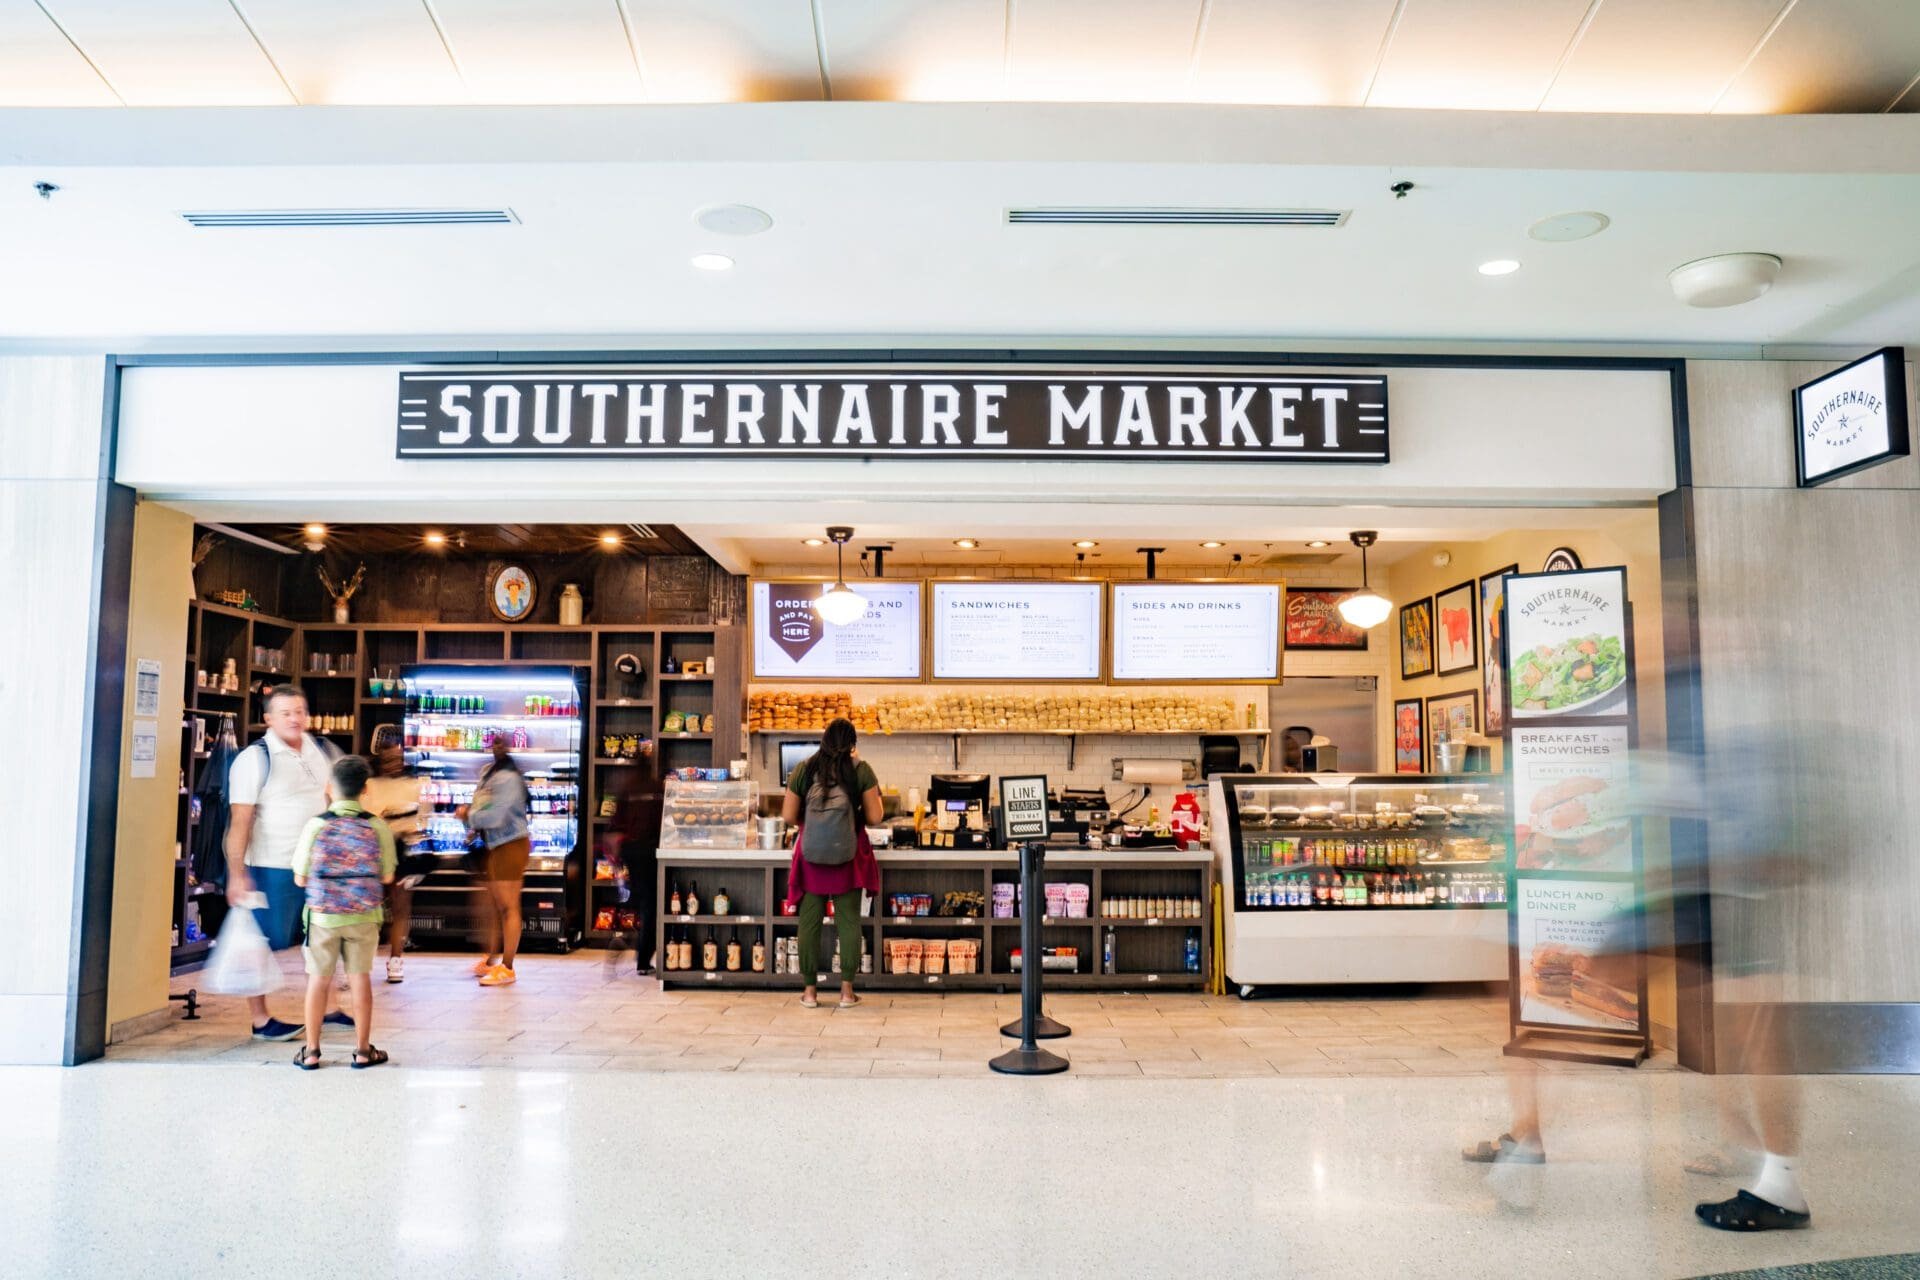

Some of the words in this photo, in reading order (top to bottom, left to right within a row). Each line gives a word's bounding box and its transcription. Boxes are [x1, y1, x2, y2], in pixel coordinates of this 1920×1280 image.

[438, 384, 1009, 444] SOUTHERNAIRE
[1047, 385, 1349, 447] MARKET
[1808, 390, 1882, 440] SOUTHERNAIRE
[1826, 425, 1864, 447] MARKET
[951, 601, 1031, 609] SANDWICHES
[1132, 602, 1166, 610] SIDES
[1170, 602, 1194, 610] AND
[1198, 602, 1242, 611] DRINKS
[1520, 588, 1610, 617] SOUTHERNAIRE
[779, 611, 796, 622] AND
[797, 611, 815, 621] PAY
[1543, 615, 1588, 627] MARKET
[782, 628, 810, 636] HERE
[1521, 734, 1598, 743] BREAKFAST
[1521, 746, 1610, 755] SANDWICHES
[1012, 787, 1037, 799] LINE
[1011, 801, 1040, 811] STARTS
[1526, 889, 1571, 899] LUNCH
[1575, 891, 1604, 900] AND
[1526, 901, 1577, 911] DINNER
